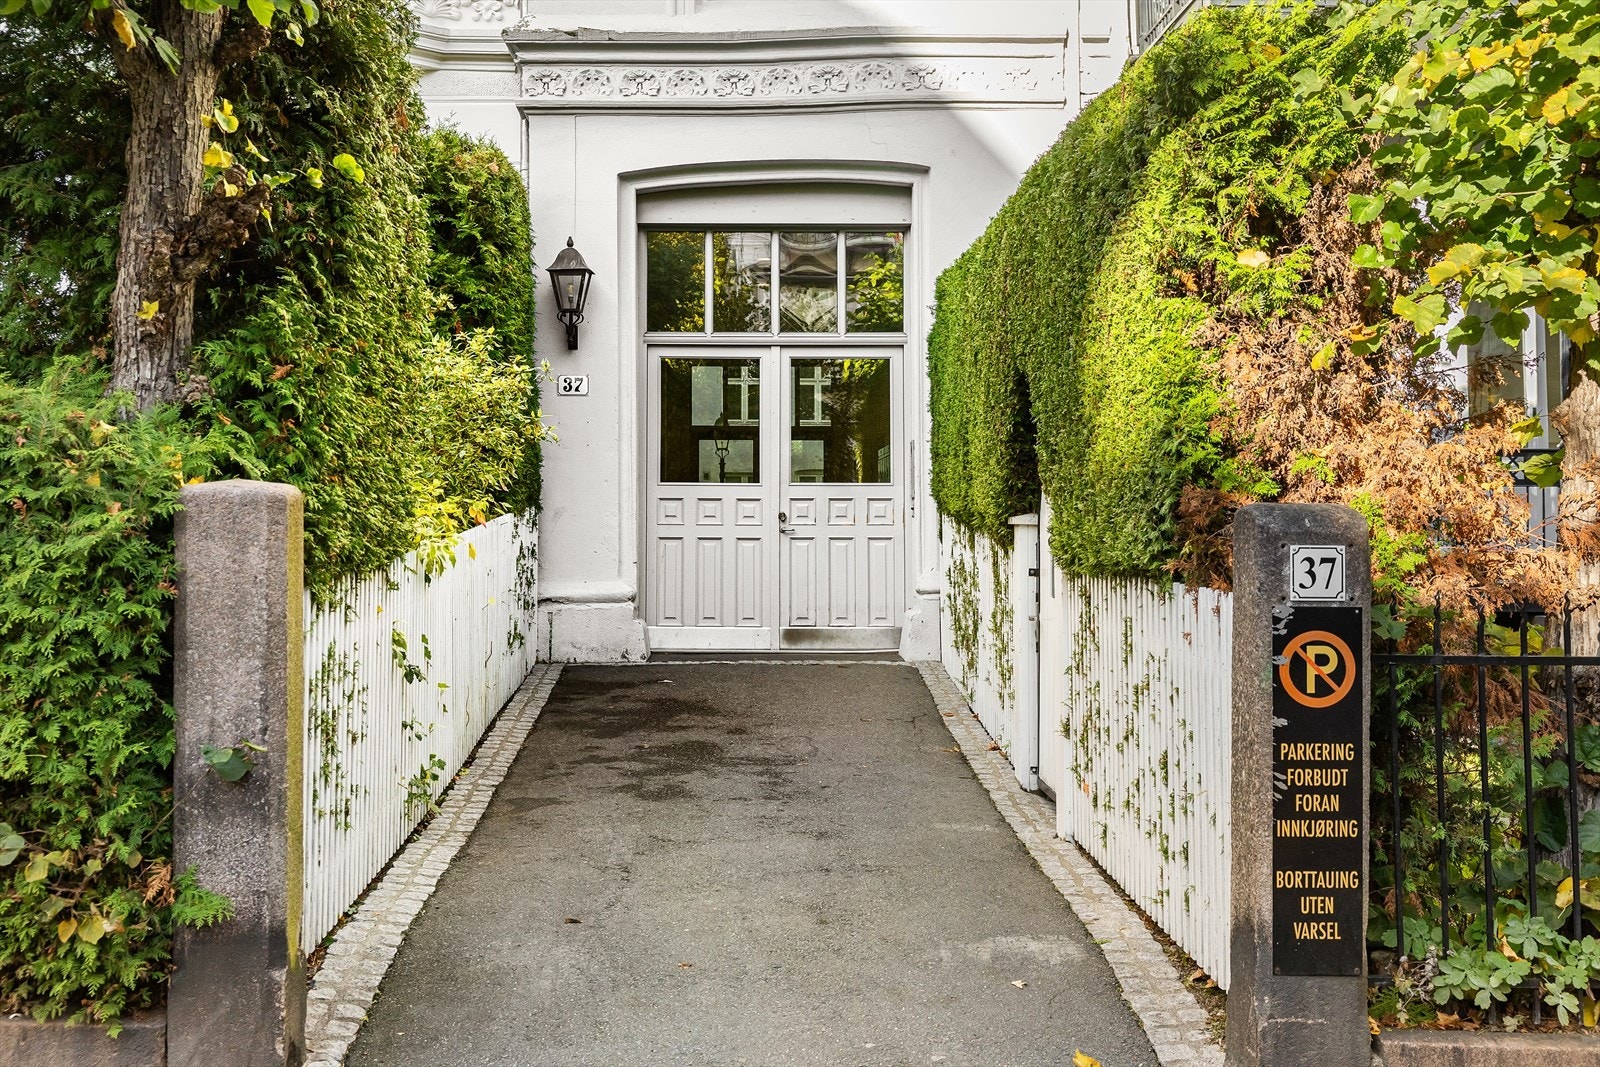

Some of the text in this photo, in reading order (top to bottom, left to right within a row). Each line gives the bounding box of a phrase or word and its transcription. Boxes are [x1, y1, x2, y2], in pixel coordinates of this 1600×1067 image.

[563, 377, 584, 392] 37
[1298, 556, 1337, 590] 37
[1306, 645, 1339, 694] P
[1280, 743, 1355, 761] PARKERING
[1287, 768, 1348, 787] FORBUDT
[1295, 794, 1340, 812] FORAN
[1276, 819, 1358, 838] INNKJØRING
[1276, 870, 1359, 889] BORTTAUING
[1300, 896, 1334, 914] UTEN
[1293, 921, 1341, 940] VARSEL
